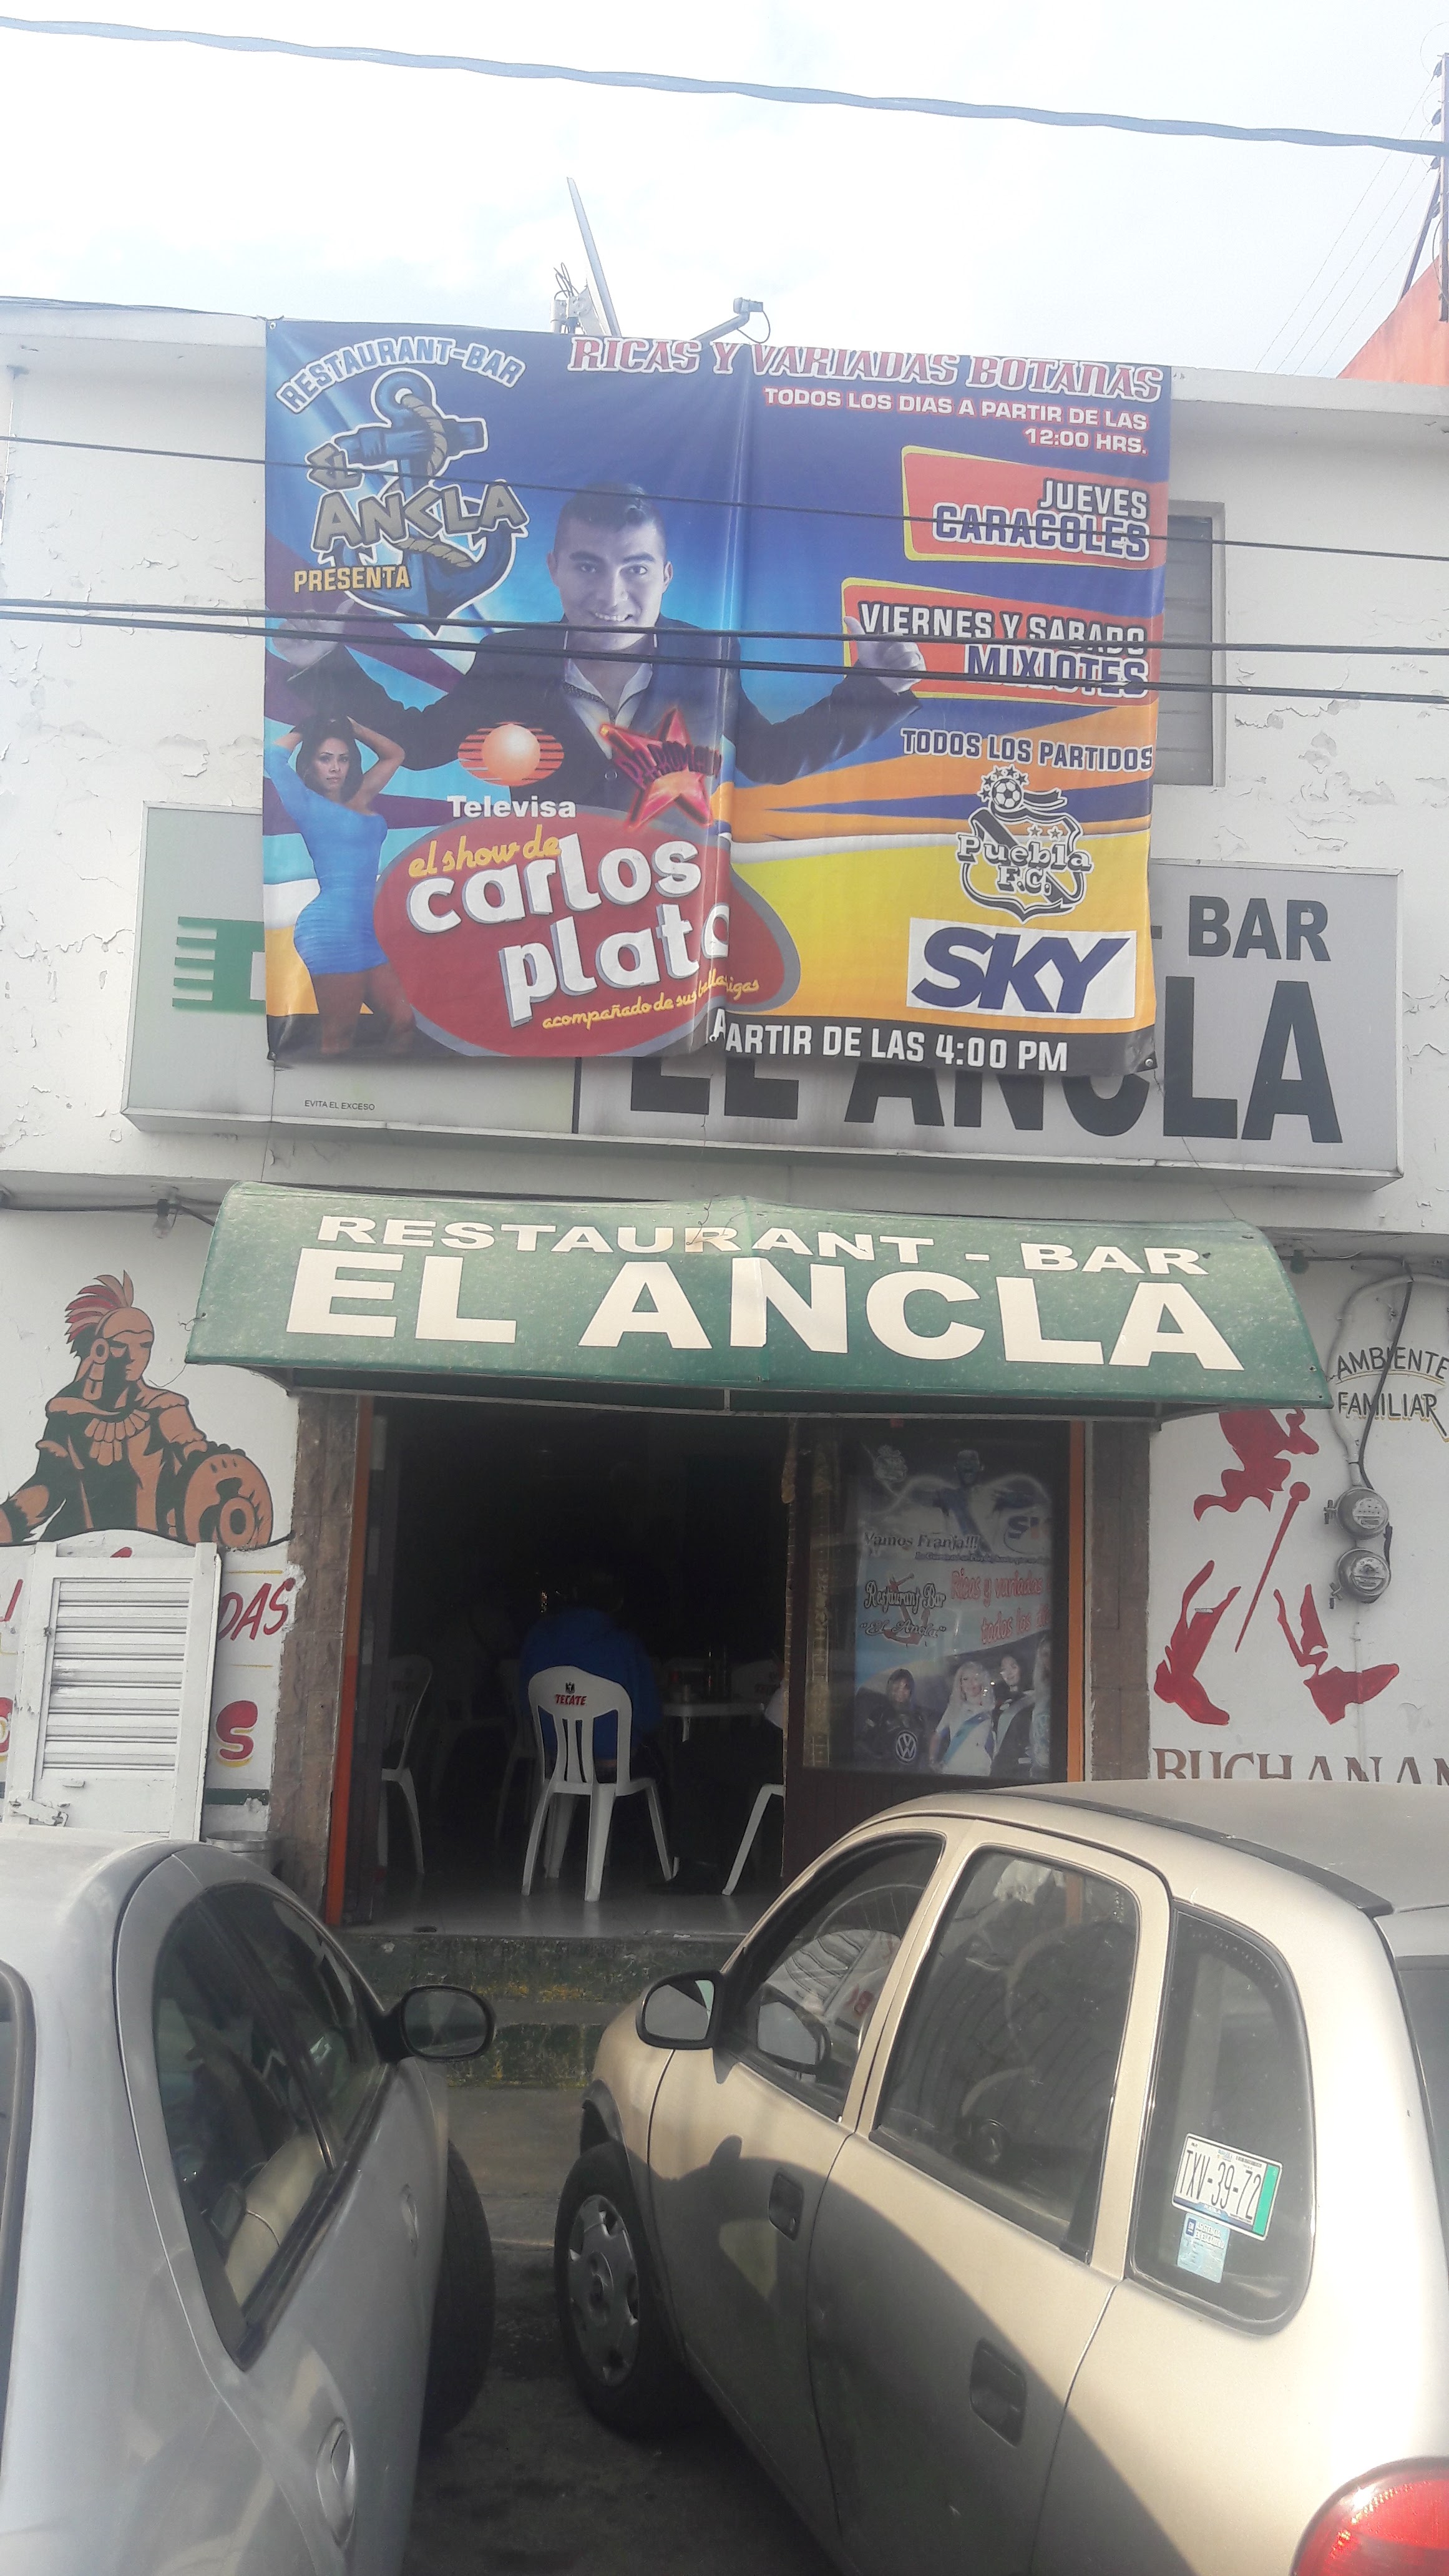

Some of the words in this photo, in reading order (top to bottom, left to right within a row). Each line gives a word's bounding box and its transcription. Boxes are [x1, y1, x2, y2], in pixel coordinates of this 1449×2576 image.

[276, 336, 525, 413] RESTAURANT-BAR
[567, 337, 701, 374] RICAS
[710, 341, 746, 374] Y
[751, 344, 959, 386] VARIADAS
[966, 355, 1164, 403] BOTANAS
[765, 387, 842, 407] TODOS
[847, 393, 892, 411] LOS
[899, 394, 952, 414] DIAS
[959, 400, 975, 416] A
[982, 399, 1062, 422] PARTIR
[1069, 408, 1098, 426] DE
[1105, 411, 1148, 431] LAS
[1025, 428, 1090, 448] 12:00
[1096, 434, 1148, 454] HRS.
[308, 442, 363, 491] EL
[312, 481, 530, 552] ANCLA
[1039, 479, 1149, 520] JUEVES
[932, 502, 1151, 561] CARACOLES
[293, 564, 411, 593] PRESENTA
[860, 603, 992, 638] VIERNES
[1002, 613, 1020, 640] Y
[1028, 616, 1146, 656] SABADO
[965, 644, 1149, 698] MIXIOTES
[900, 728, 983, 758] TODOS
[987, 734, 1033, 764] LOS
[1037, 741, 1153, 773] PARTIDOS
[446, 795, 576, 818] Televisa
[408, 840, 437, 877] el
[441, 835, 520, 872] show
[522, 824, 562, 860] de
[957, 834, 1093, 872] Puebla
[407, 833, 702, 934] carlos
[997, 864, 1051, 897] F.C.
[1188, 895, 1332, 962] BAR
[910, 927, 1131, 1015] SKY
[542, 995, 651, 1031] acompañado
[653, 992, 675, 1012] de
[675, 992, 697, 1008] sus
[725, 1023, 812, 1056] ARTIR
[822, 1025, 862, 1058] DE
[871, 1027, 925, 1063] LAS
[935, 1033, 1008, 1070] 4:00
[1018, 1040, 1068, 1072] PM
[305, 1100, 328, 1108] EVITA
[341, 1102, 375, 1111] EXCESO
[317, 1215, 934, 1264] RESTAURANT
[1020, 1242, 1209, 1276] BAR
[286, 1247, 517, 1344] EL
[578, 1256, 1245, 1372] ANCLA
[1337, 1392, 1447, 1437] FAMILIAR
[922, 1583, 947, 1609] Bar
[555, 1694, 587, 1705] TECATE
[1179, 2149, 1262, 2220] TXV-39-72
